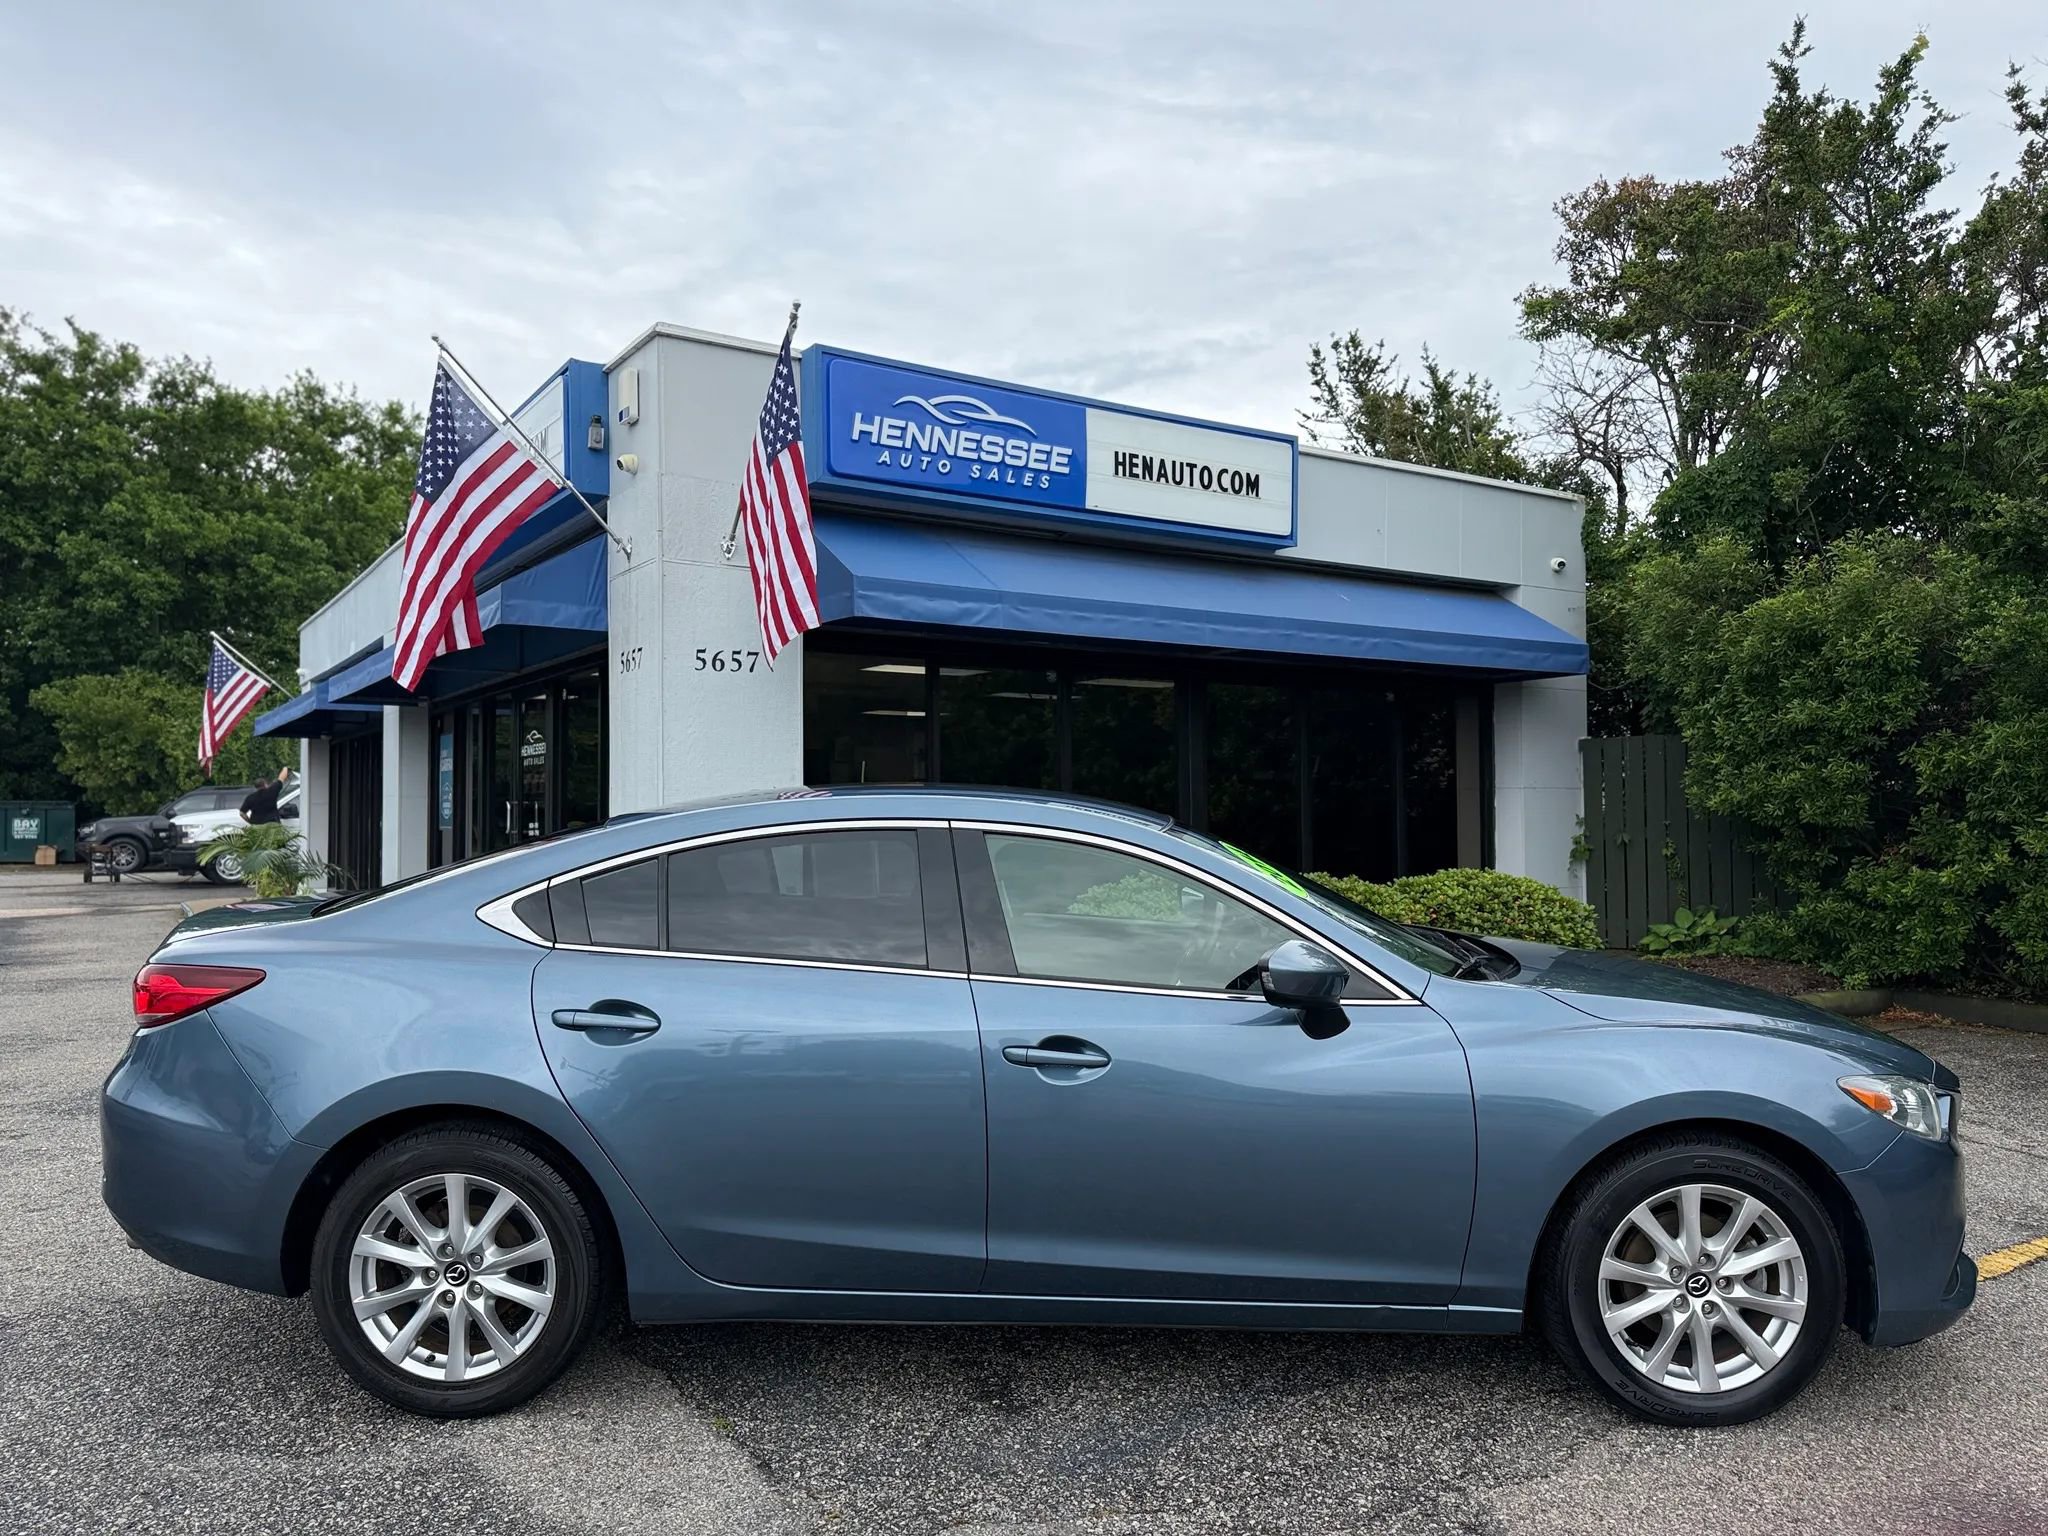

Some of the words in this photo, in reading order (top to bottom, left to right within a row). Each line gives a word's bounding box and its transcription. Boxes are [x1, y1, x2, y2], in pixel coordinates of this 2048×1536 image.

[851, 412, 1073, 475] HENNESSEE
[878, 450, 952, 474] AUTO
[970, 464, 1051, 489] SALES
[620, 647, 643, 674] 5657
[694, 648, 760, 673] 5657
